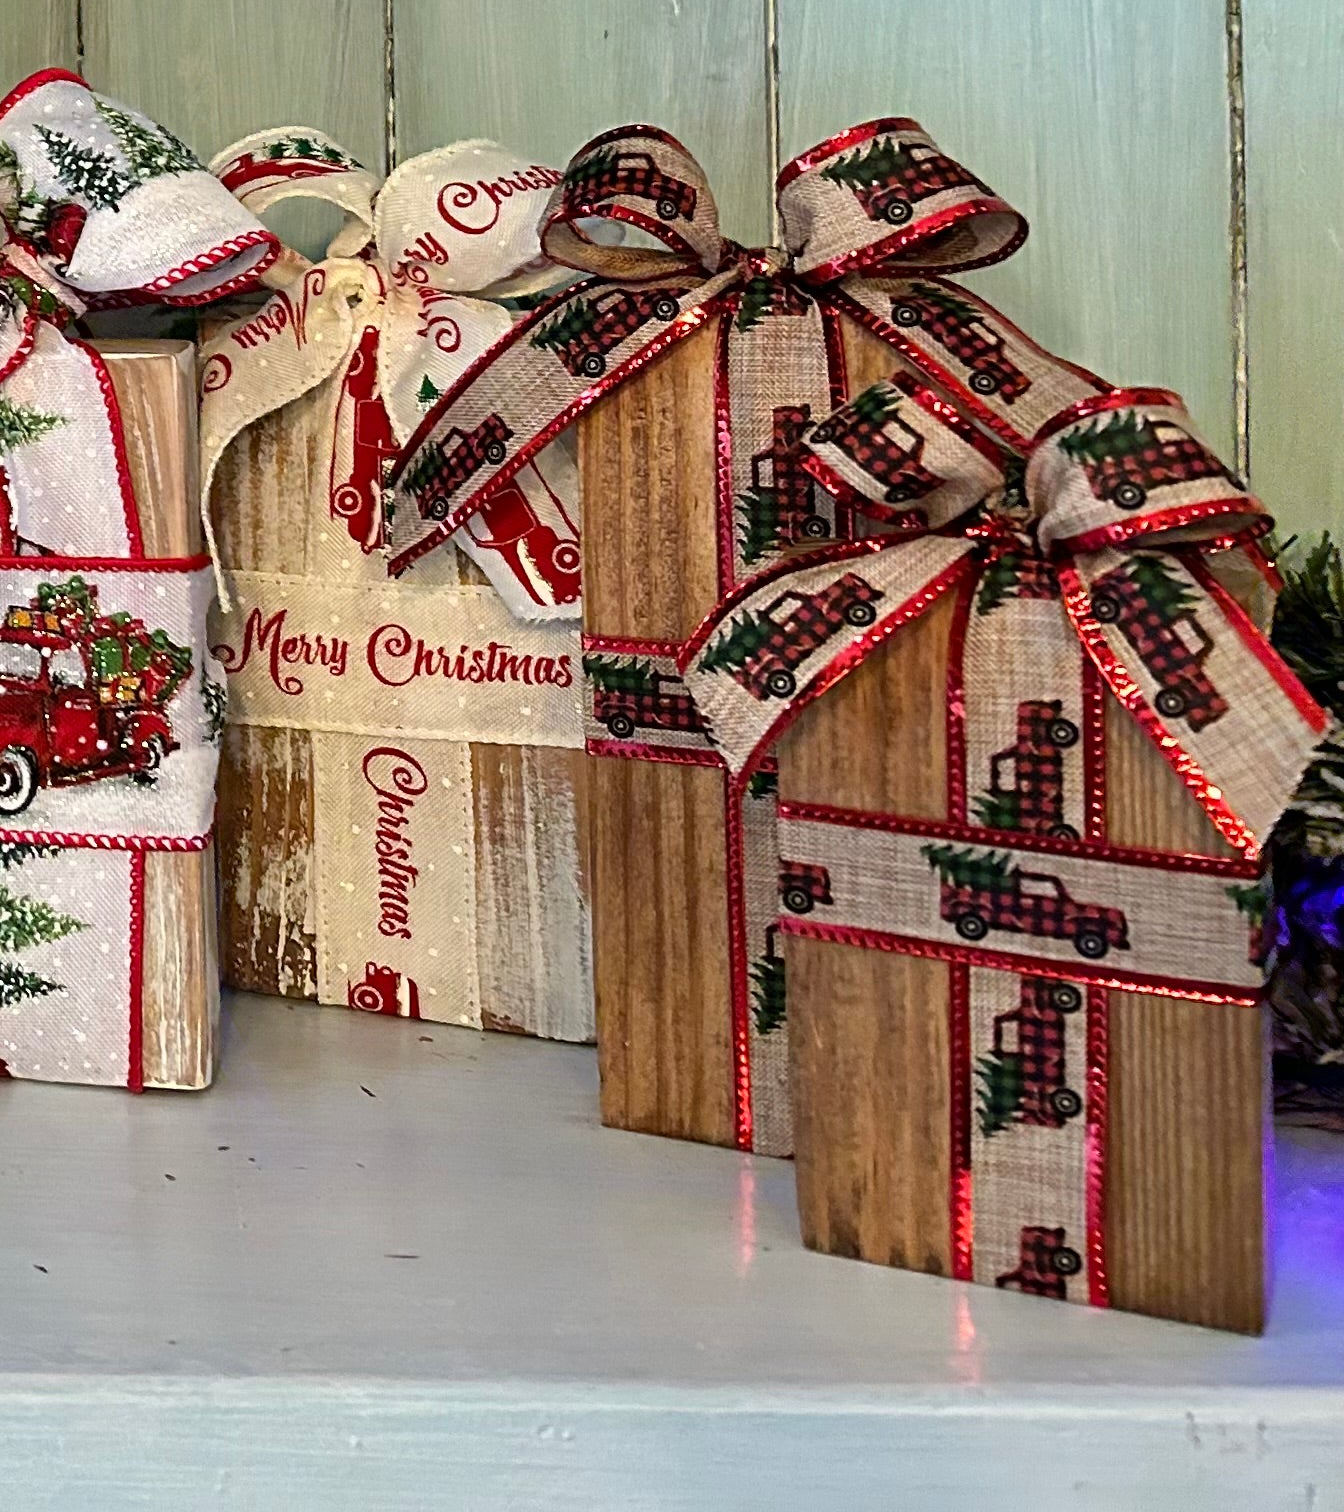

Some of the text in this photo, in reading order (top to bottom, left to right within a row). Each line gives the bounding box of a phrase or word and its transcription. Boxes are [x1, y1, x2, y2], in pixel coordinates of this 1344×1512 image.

[212, 607, 574, 696] Merry Christmas
[362, 746, 428, 940] Christmas
